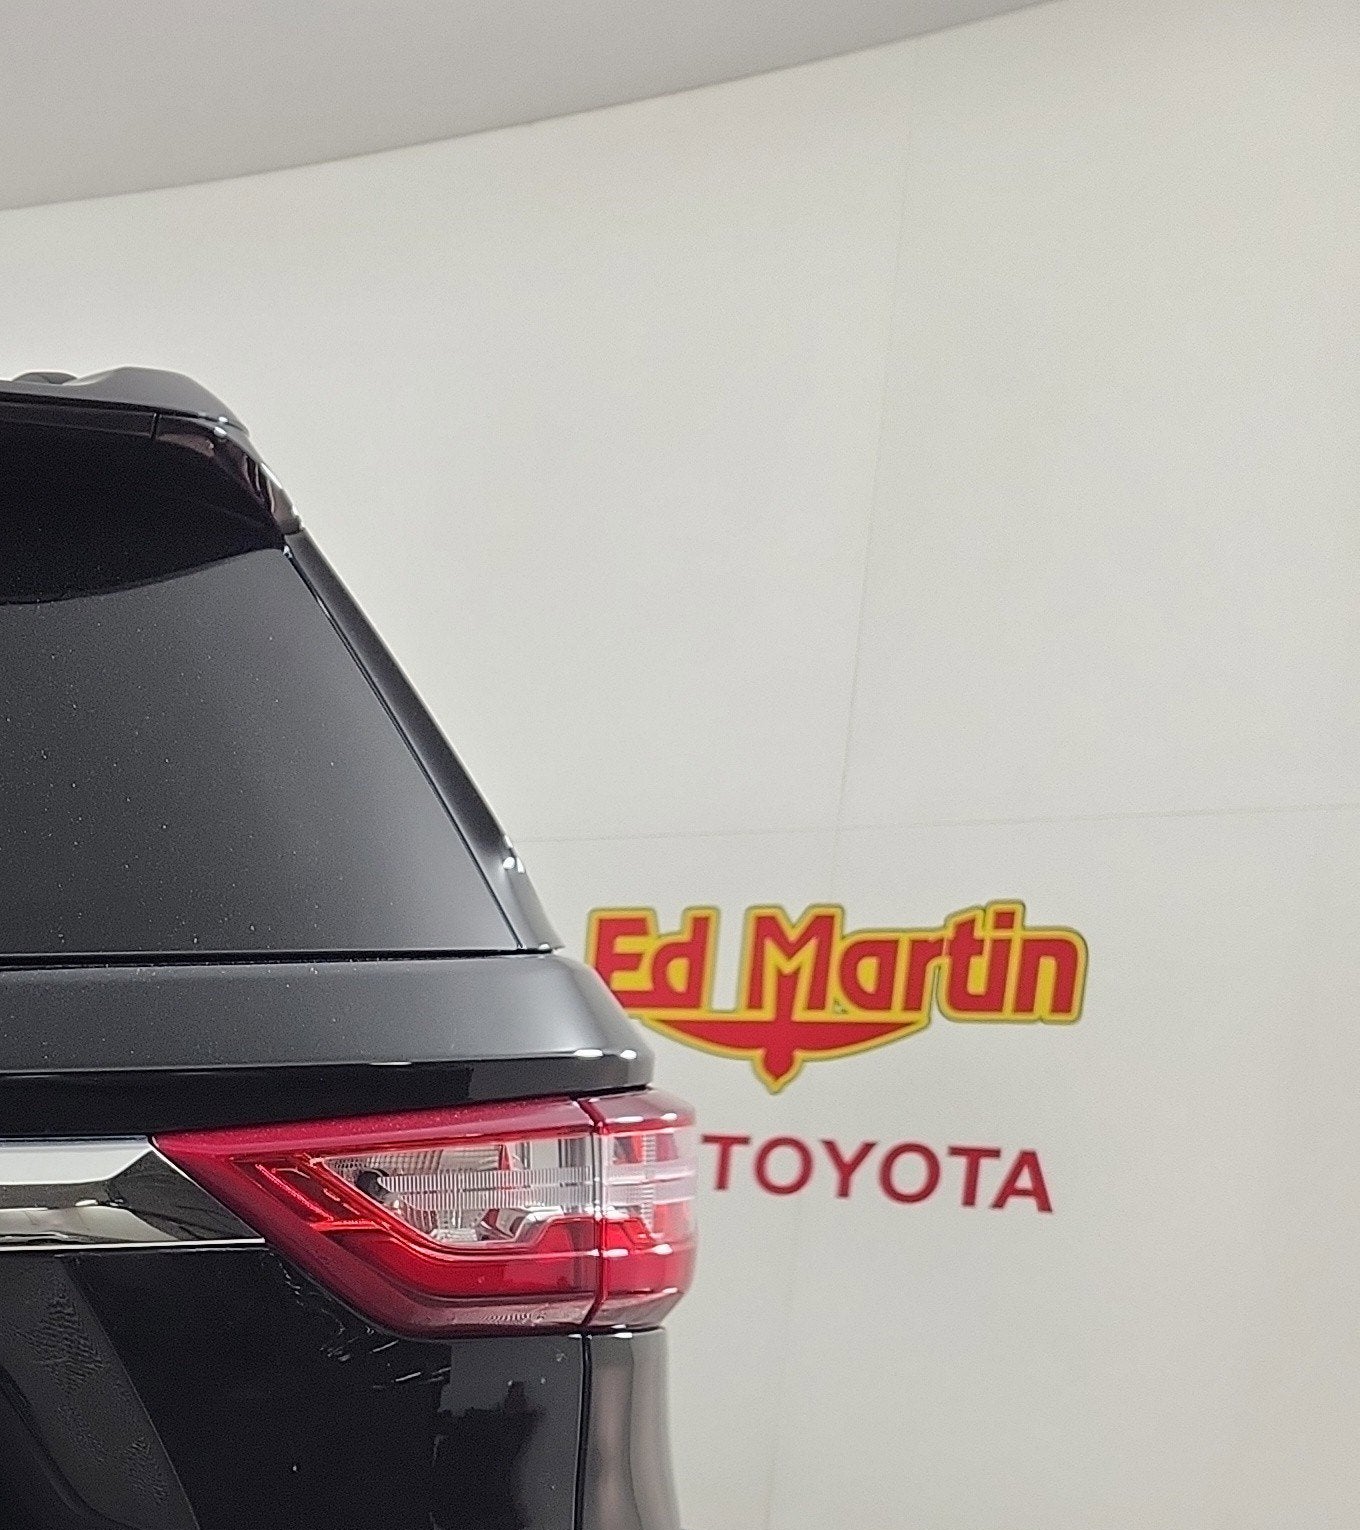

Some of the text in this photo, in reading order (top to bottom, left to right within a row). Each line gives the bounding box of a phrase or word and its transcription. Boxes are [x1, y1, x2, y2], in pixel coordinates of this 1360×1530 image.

[587, 899, 1088, 1093] Ed Martin
[701, 1133, 1054, 1213] TOYOTA
